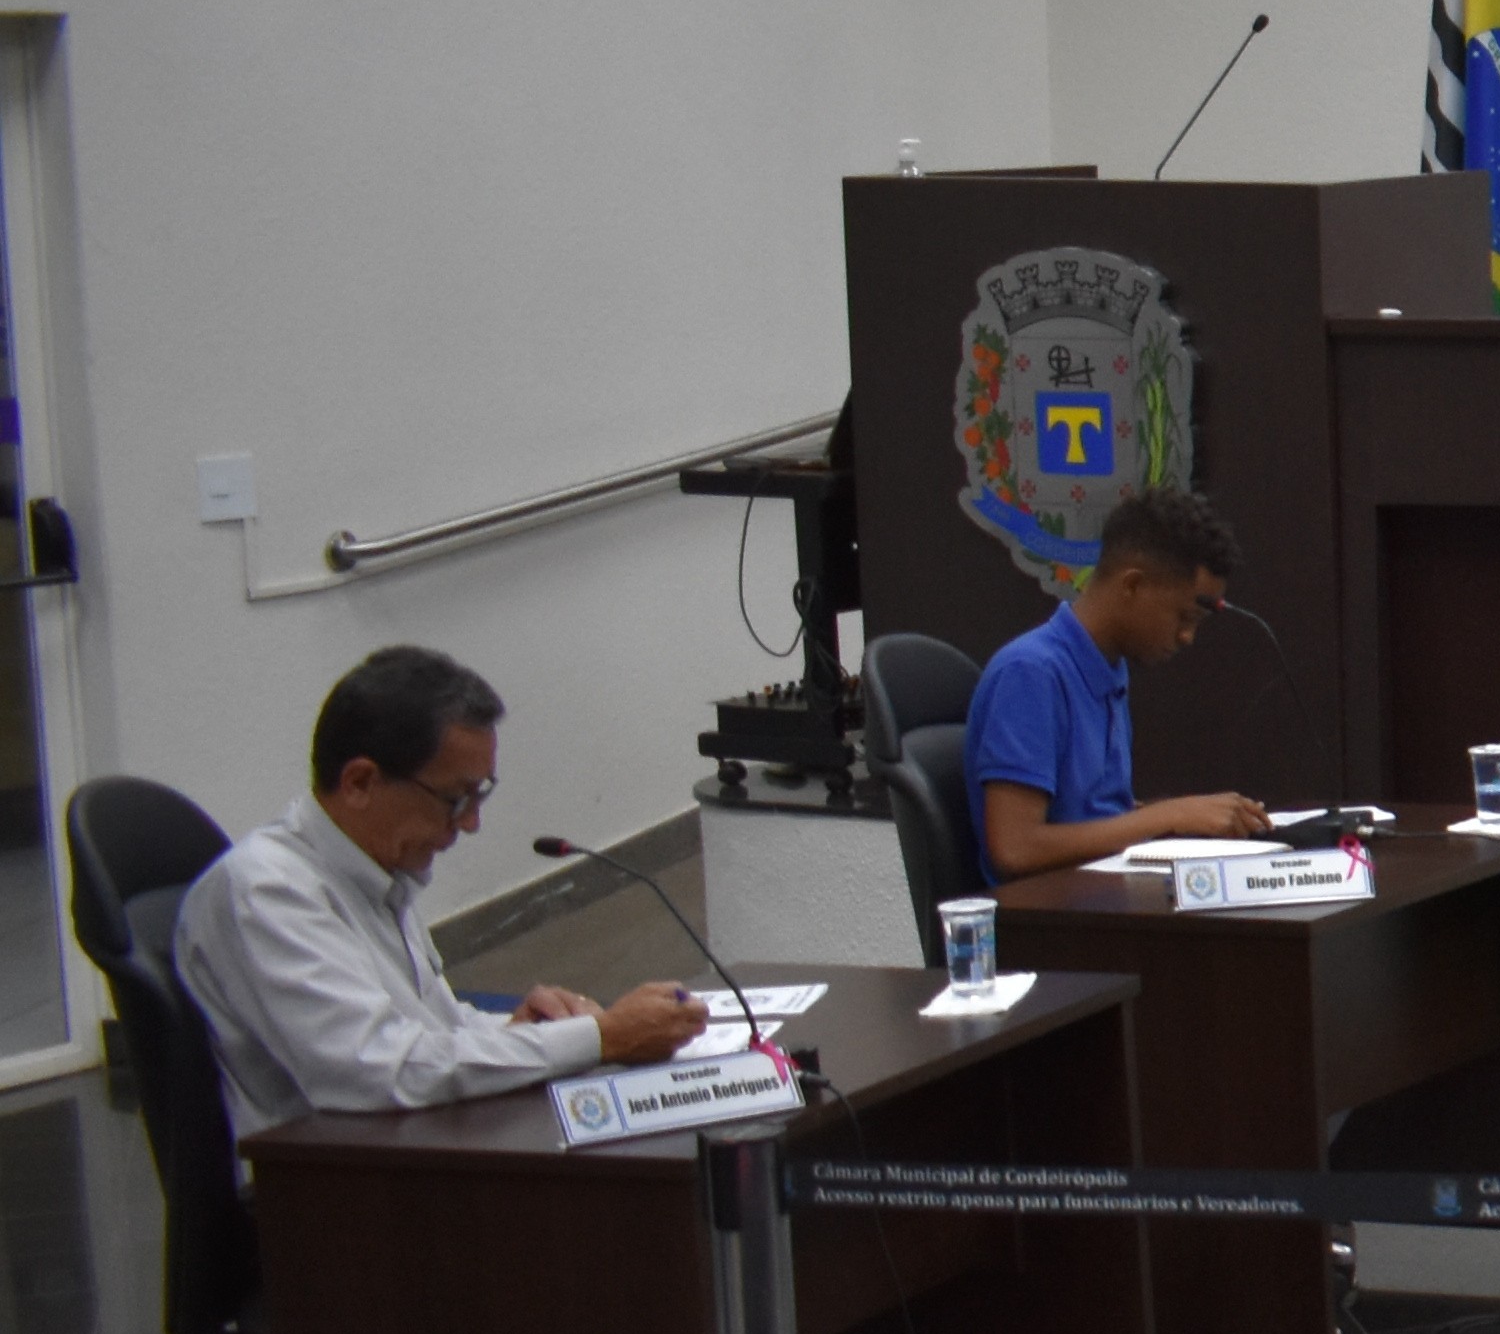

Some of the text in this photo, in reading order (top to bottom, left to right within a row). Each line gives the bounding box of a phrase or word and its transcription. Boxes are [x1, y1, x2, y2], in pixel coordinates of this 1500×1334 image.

[1270, 858, 1312, 868] Vereador
[1246, 873, 1343, 890] Diego Fabiano
[671, 1067, 721, 1081] Vereador
[628, 1077, 780, 1114] José Antonio Rodrigues
